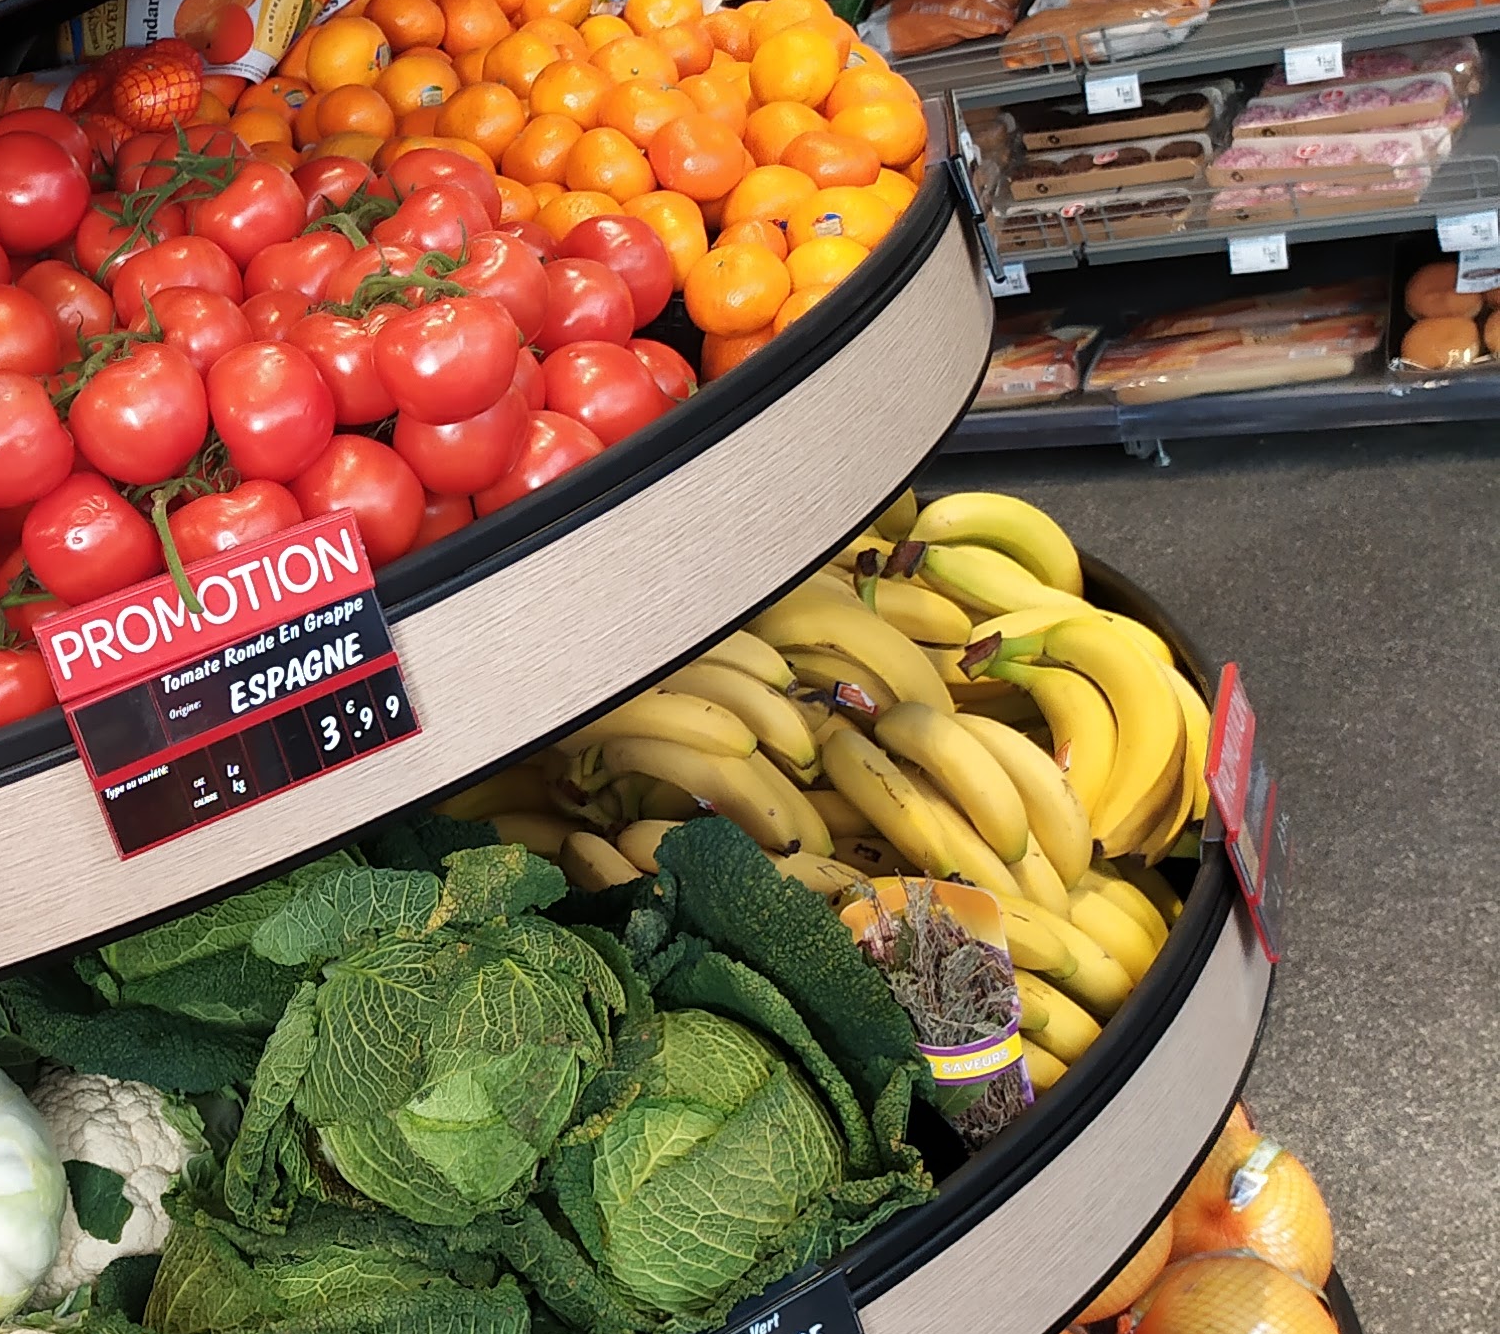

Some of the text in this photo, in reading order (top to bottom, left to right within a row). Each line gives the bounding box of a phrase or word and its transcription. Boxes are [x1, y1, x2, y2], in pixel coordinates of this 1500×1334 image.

[50, 528, 360, 682] PROMOTION
[161, 596, 364, 696] Tomate Ronde En Grappe
[168, 631, 365, 722] Origine: ESPAGNE
[226, 763, 240, 778] Le
[104, 781, 126, 801] Type
[232, 778, 247, 795] kg
[941, 1048, 1009, 1075] SAVEURS
